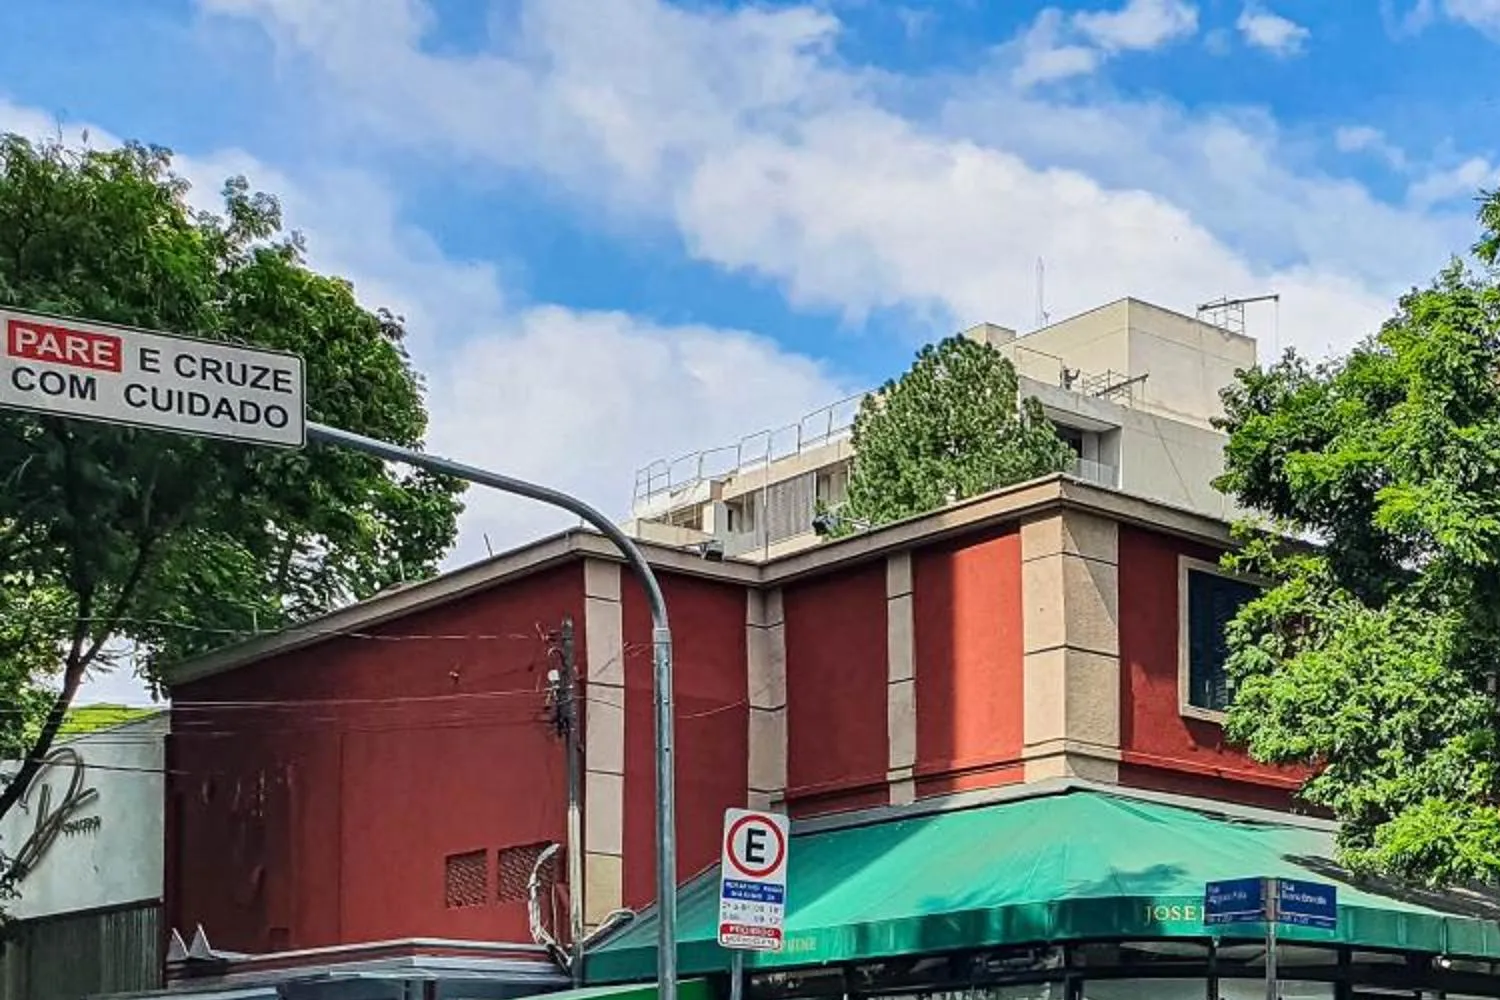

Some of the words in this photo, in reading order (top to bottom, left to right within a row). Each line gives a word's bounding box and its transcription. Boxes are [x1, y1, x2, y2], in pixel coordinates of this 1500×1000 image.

[15, 327, 116, 368] PARE
[139, 347, 161, 374] E
[173, 353, 294, 394] CRUZE
[11, 366, 98, 401] COM
[123, 383, 289, 429] CUIDADO
[745, 827, 767, 864] E
[1144, 905, 1205, 926] JOSE
